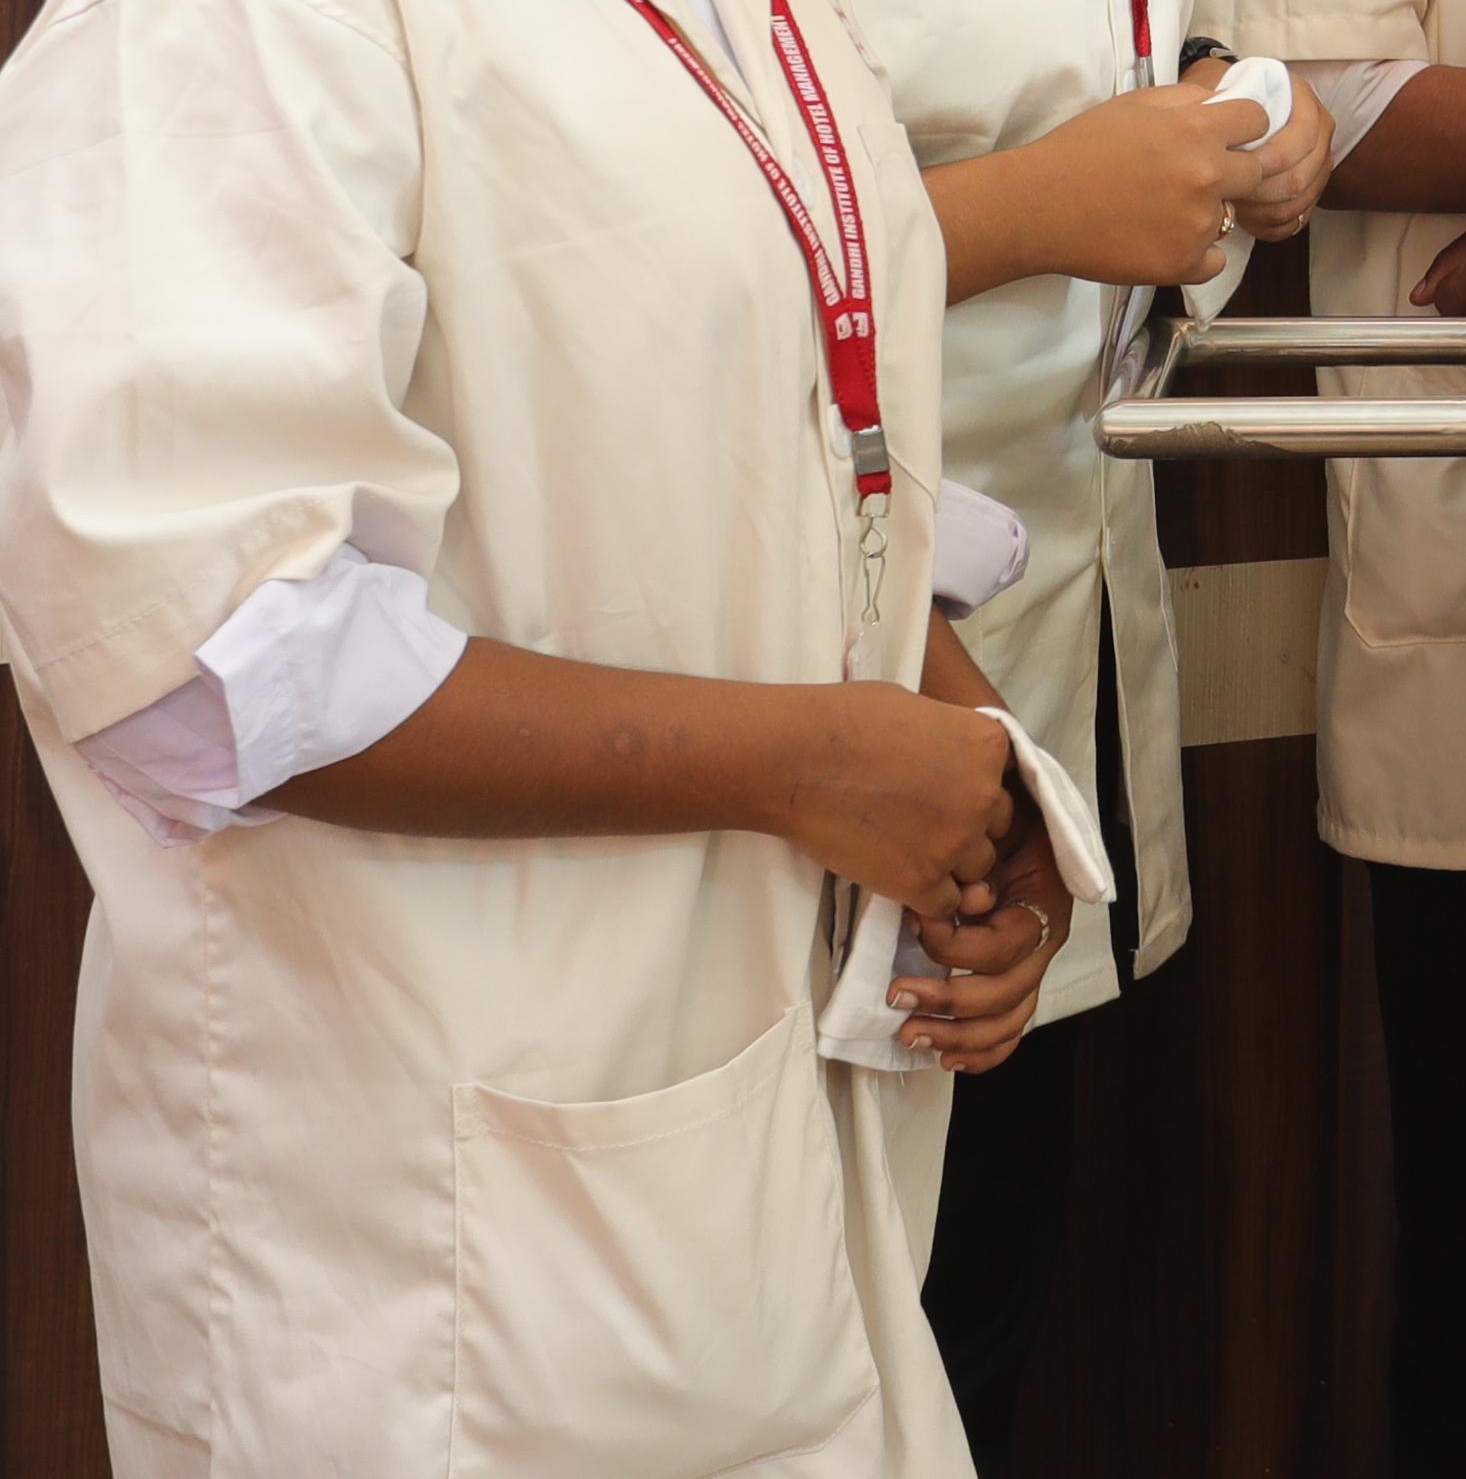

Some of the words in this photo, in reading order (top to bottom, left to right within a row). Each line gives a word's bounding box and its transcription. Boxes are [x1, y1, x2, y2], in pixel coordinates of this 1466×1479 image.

[807, 104, 836, 144] HOTEL
[822, 145, 841, 164] OF
[828, 166, 859, 239] INSTITUTE
[814, 249, 840, 307] GANDHI
[847, 242, 866, 299] GANDHI
